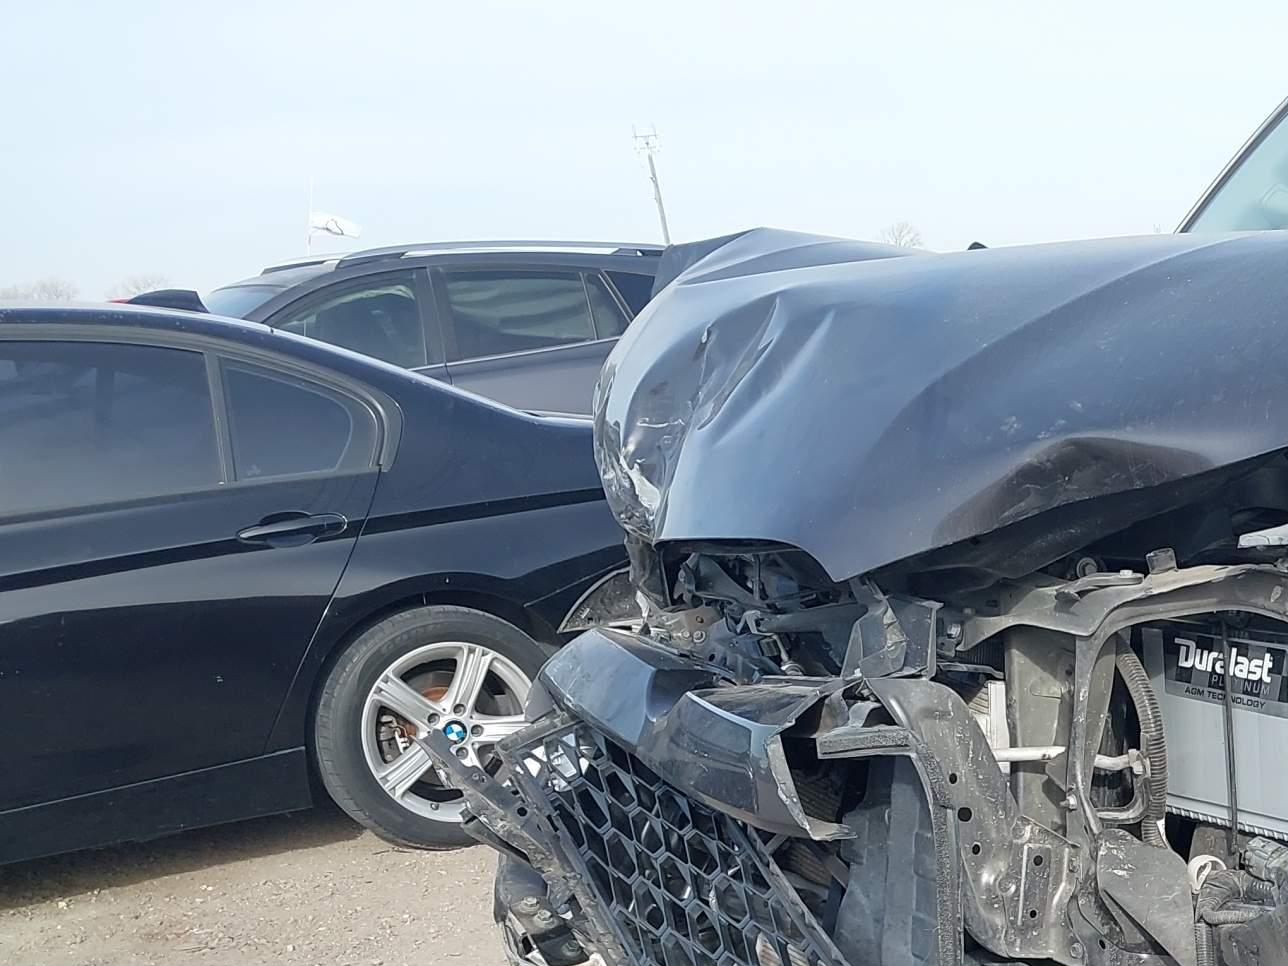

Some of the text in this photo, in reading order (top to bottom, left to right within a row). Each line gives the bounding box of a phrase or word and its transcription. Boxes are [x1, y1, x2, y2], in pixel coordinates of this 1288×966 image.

[1174, 637, 1274, 683] Duralast
[1185, 686, 1205, 697] AGM
[1211, 675, 1271, 696] PLTINUM
